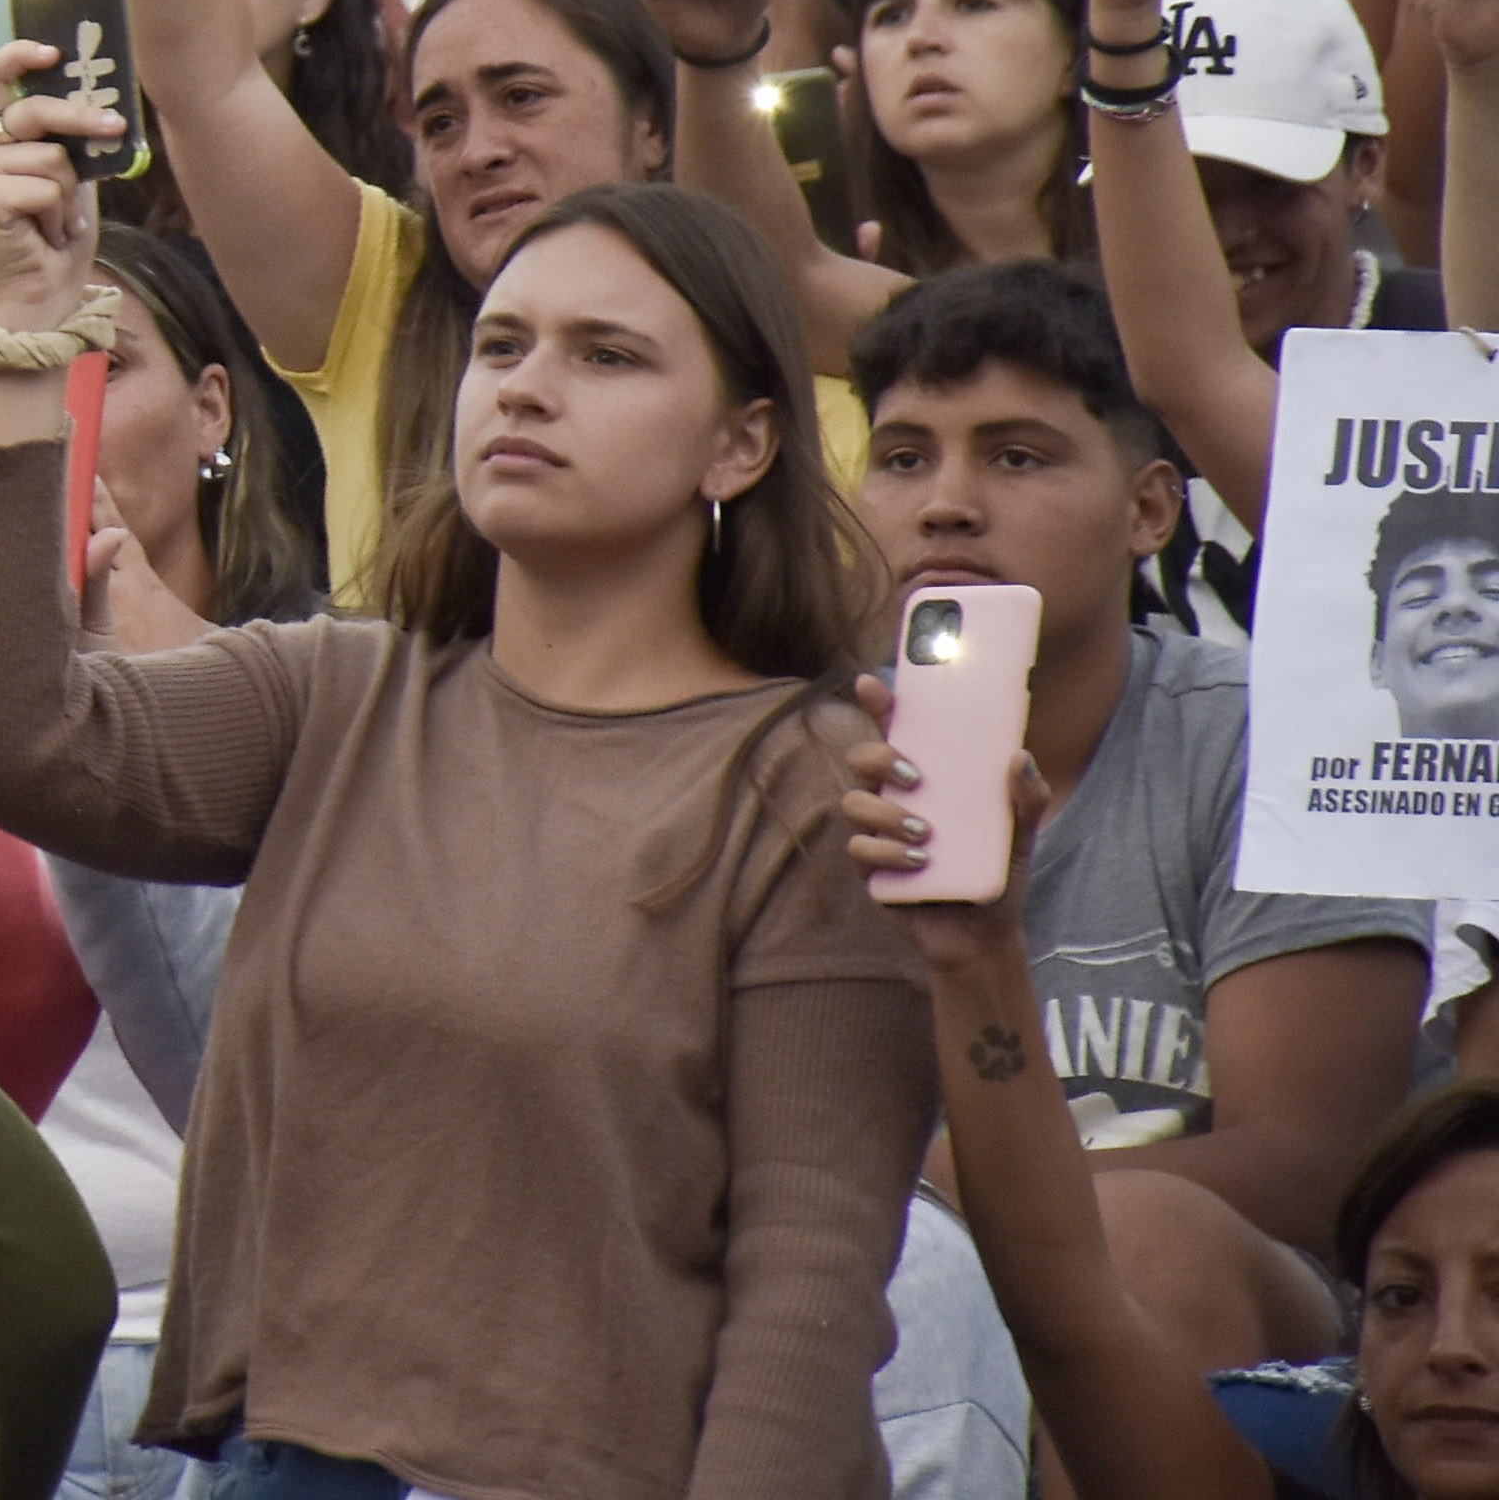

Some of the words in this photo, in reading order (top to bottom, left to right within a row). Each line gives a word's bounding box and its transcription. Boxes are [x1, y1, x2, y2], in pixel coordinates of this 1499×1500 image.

[1170, 1, 1236, 75] LA
[1311, 757, 1360, 781] por
[1371, 742, 1499, 783] FERNA
[1307, 788, 1445, 816] ASESINADO
[1453, 792, 1480, 816] EN
